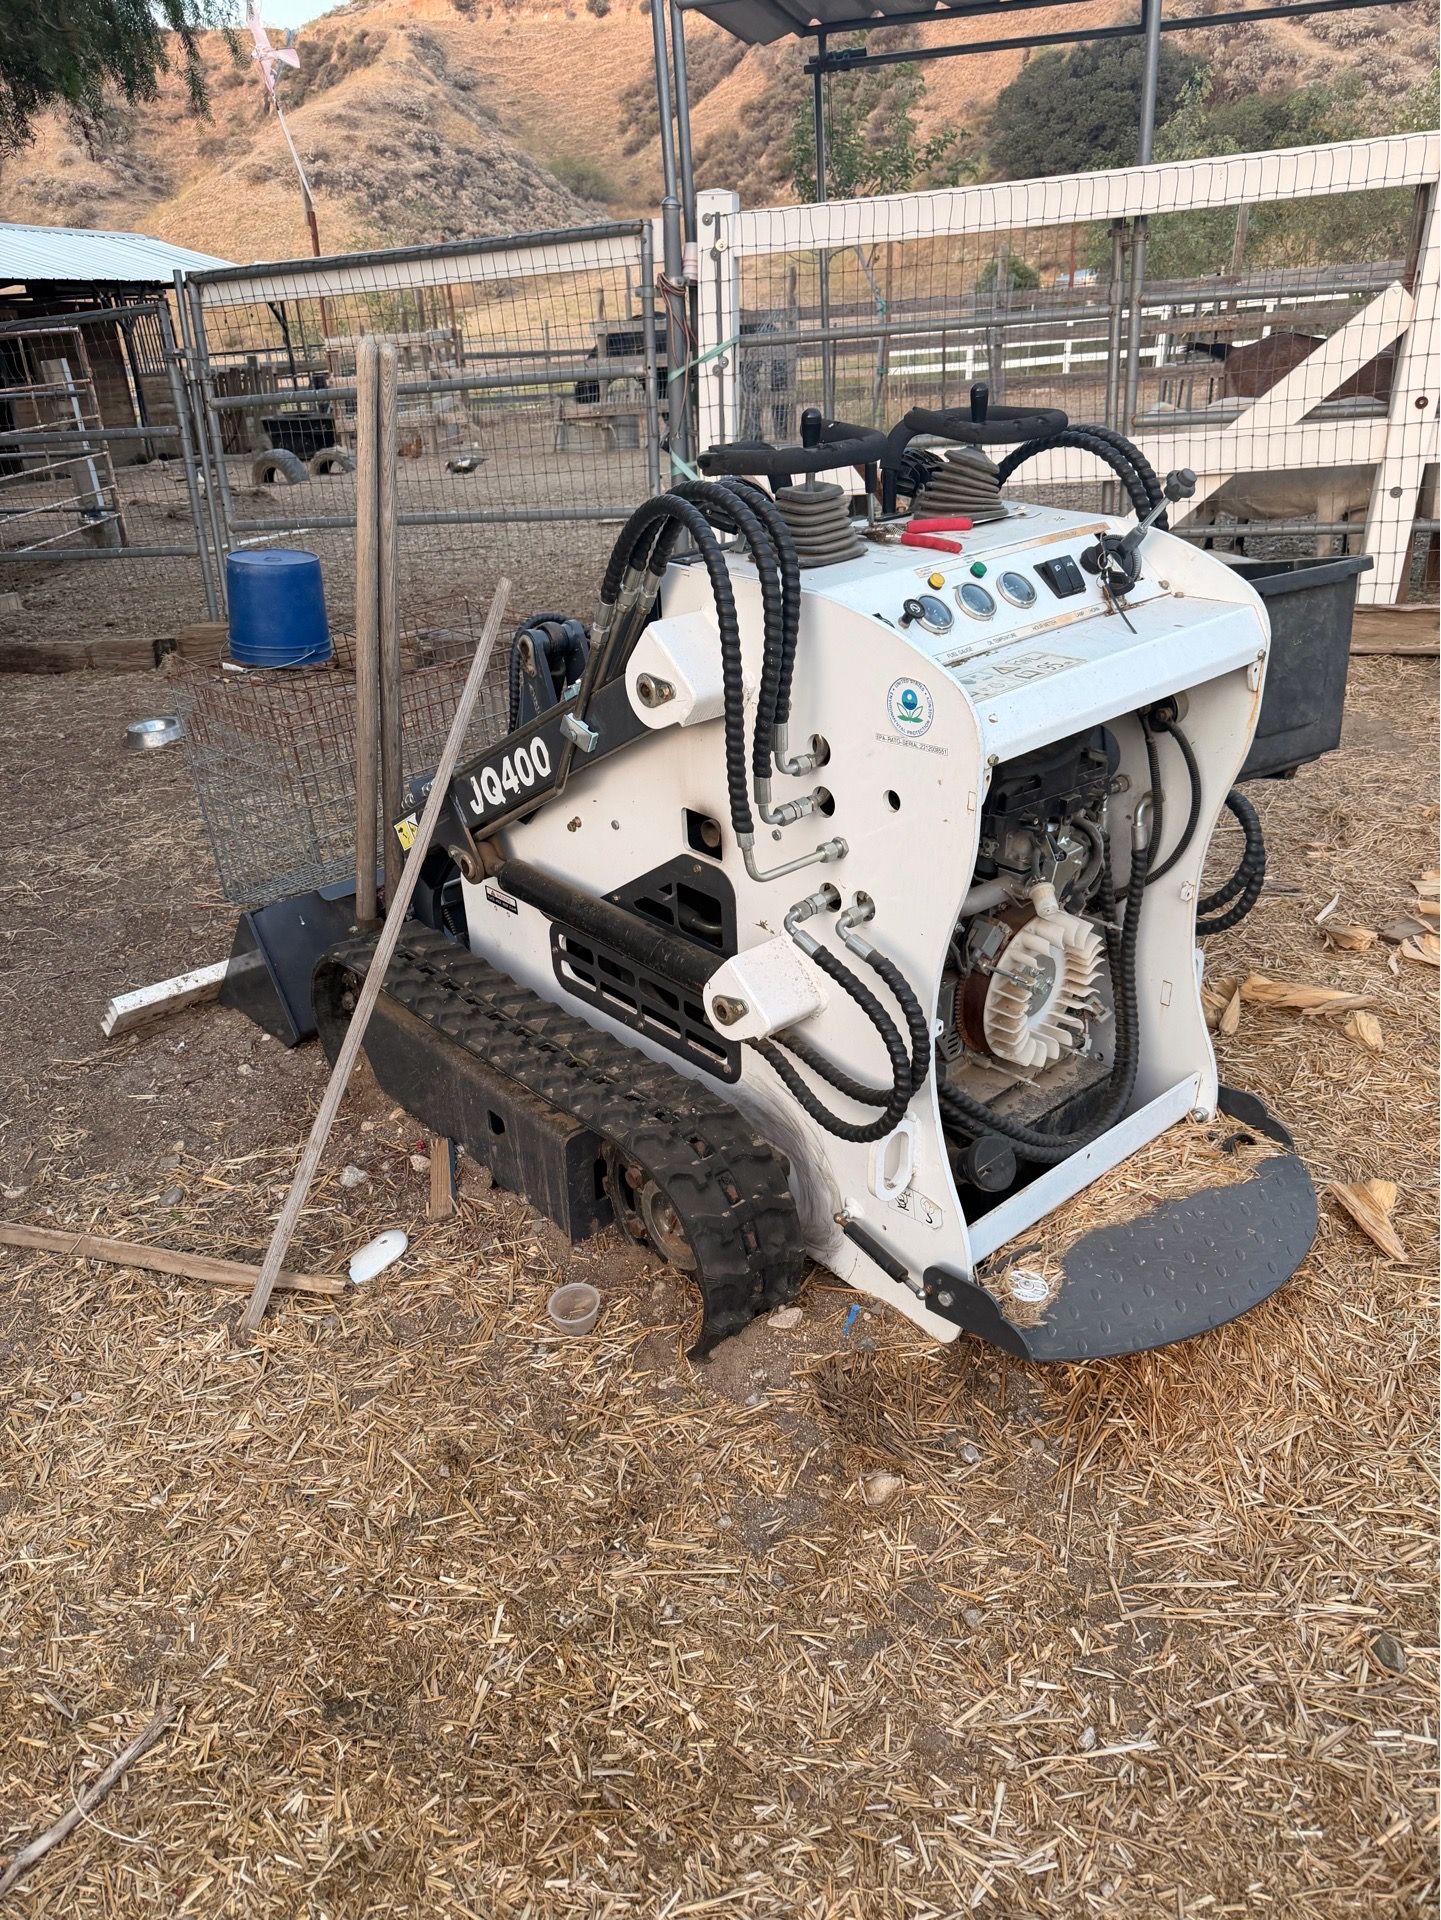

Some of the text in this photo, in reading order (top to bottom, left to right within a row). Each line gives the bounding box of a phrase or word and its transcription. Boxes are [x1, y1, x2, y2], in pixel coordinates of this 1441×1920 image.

[895, 679, 909, 688] UNITED
[906, 720, 930, 736] PROTECTION
[470, 736, 551, 815] JQ400
